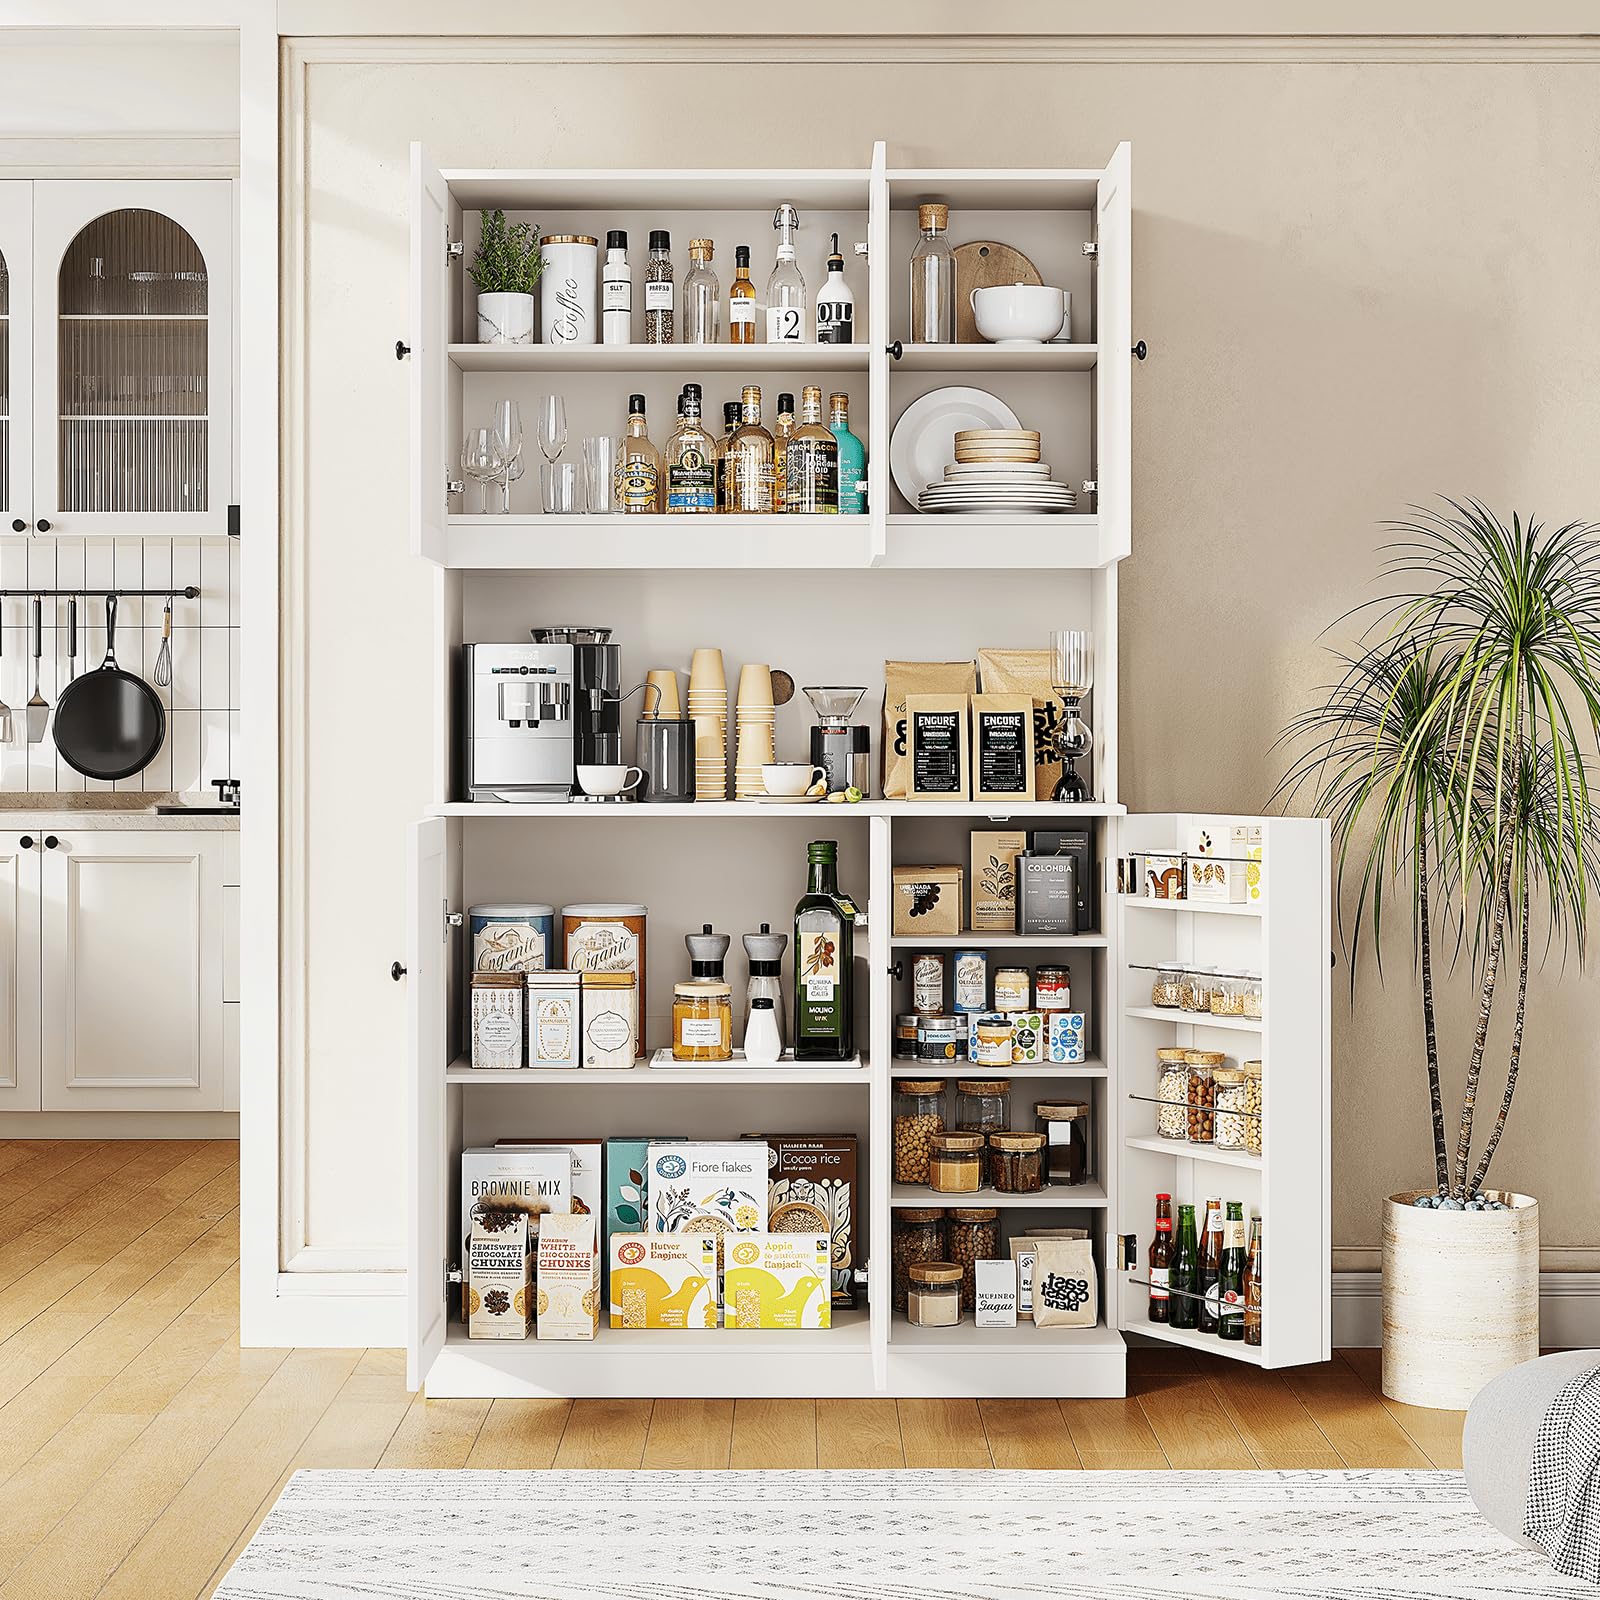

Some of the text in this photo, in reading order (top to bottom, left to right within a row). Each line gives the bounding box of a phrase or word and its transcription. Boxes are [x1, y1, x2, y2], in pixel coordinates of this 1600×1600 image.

[817, 302, 853, 323] OIL
[783, 309, 800, 340] 2
[782, 1152, 841, 1164] Cocoa rice
[471, 1180, 562, 1197] BROWNIE MIX
[540, 1243, 577, 1251] WHITE
[539, 1259, 592, 1268] CHUNKS
